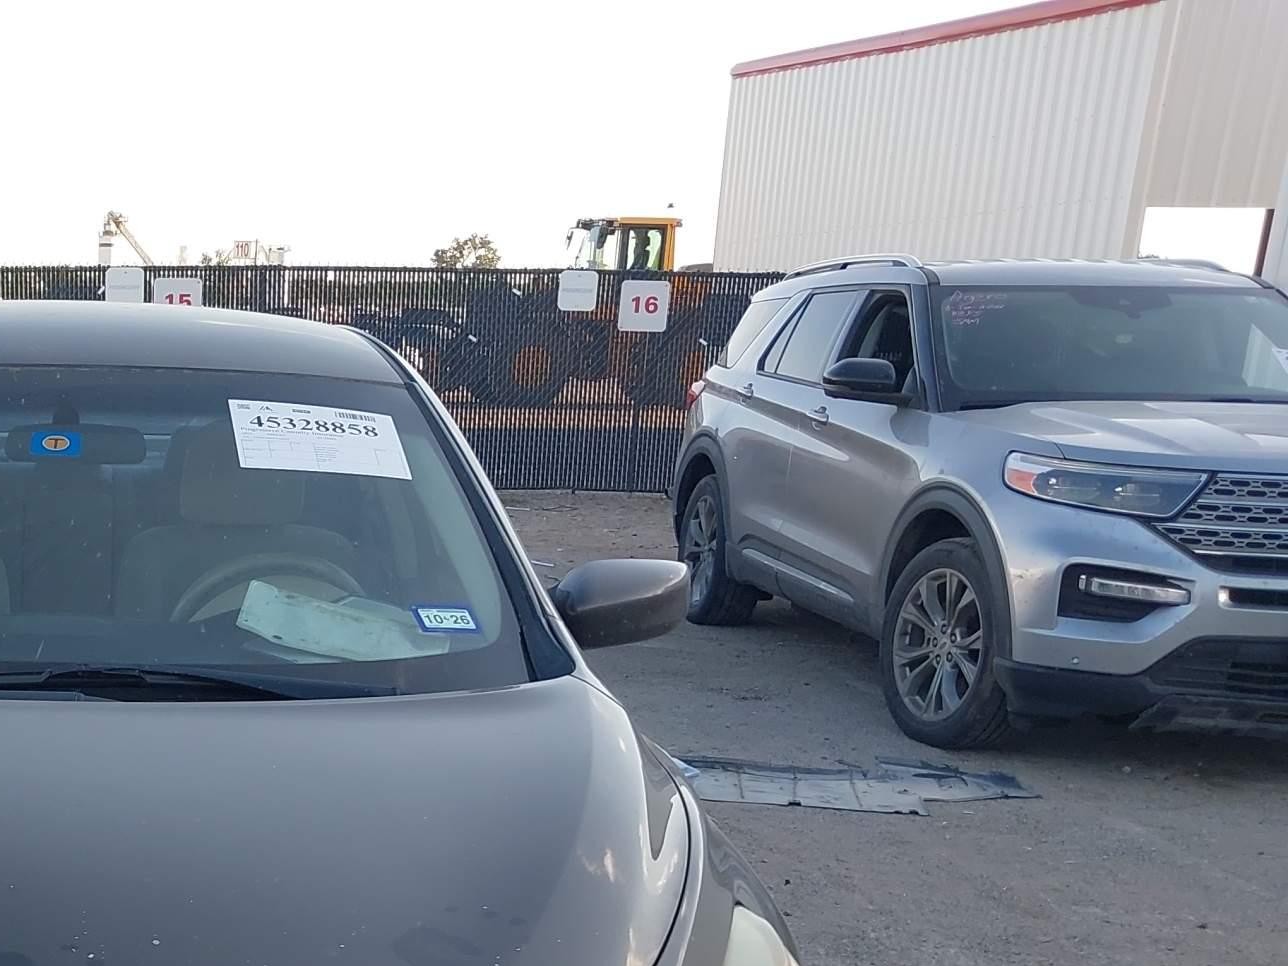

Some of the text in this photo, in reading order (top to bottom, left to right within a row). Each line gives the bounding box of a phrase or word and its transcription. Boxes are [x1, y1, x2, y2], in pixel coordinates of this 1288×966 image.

[235, 242, 250, 257] 110
[164, 293, 192, 306] 15
[631, 295, 659, 314] 16
[248, 415, 379, 438] 45328858
